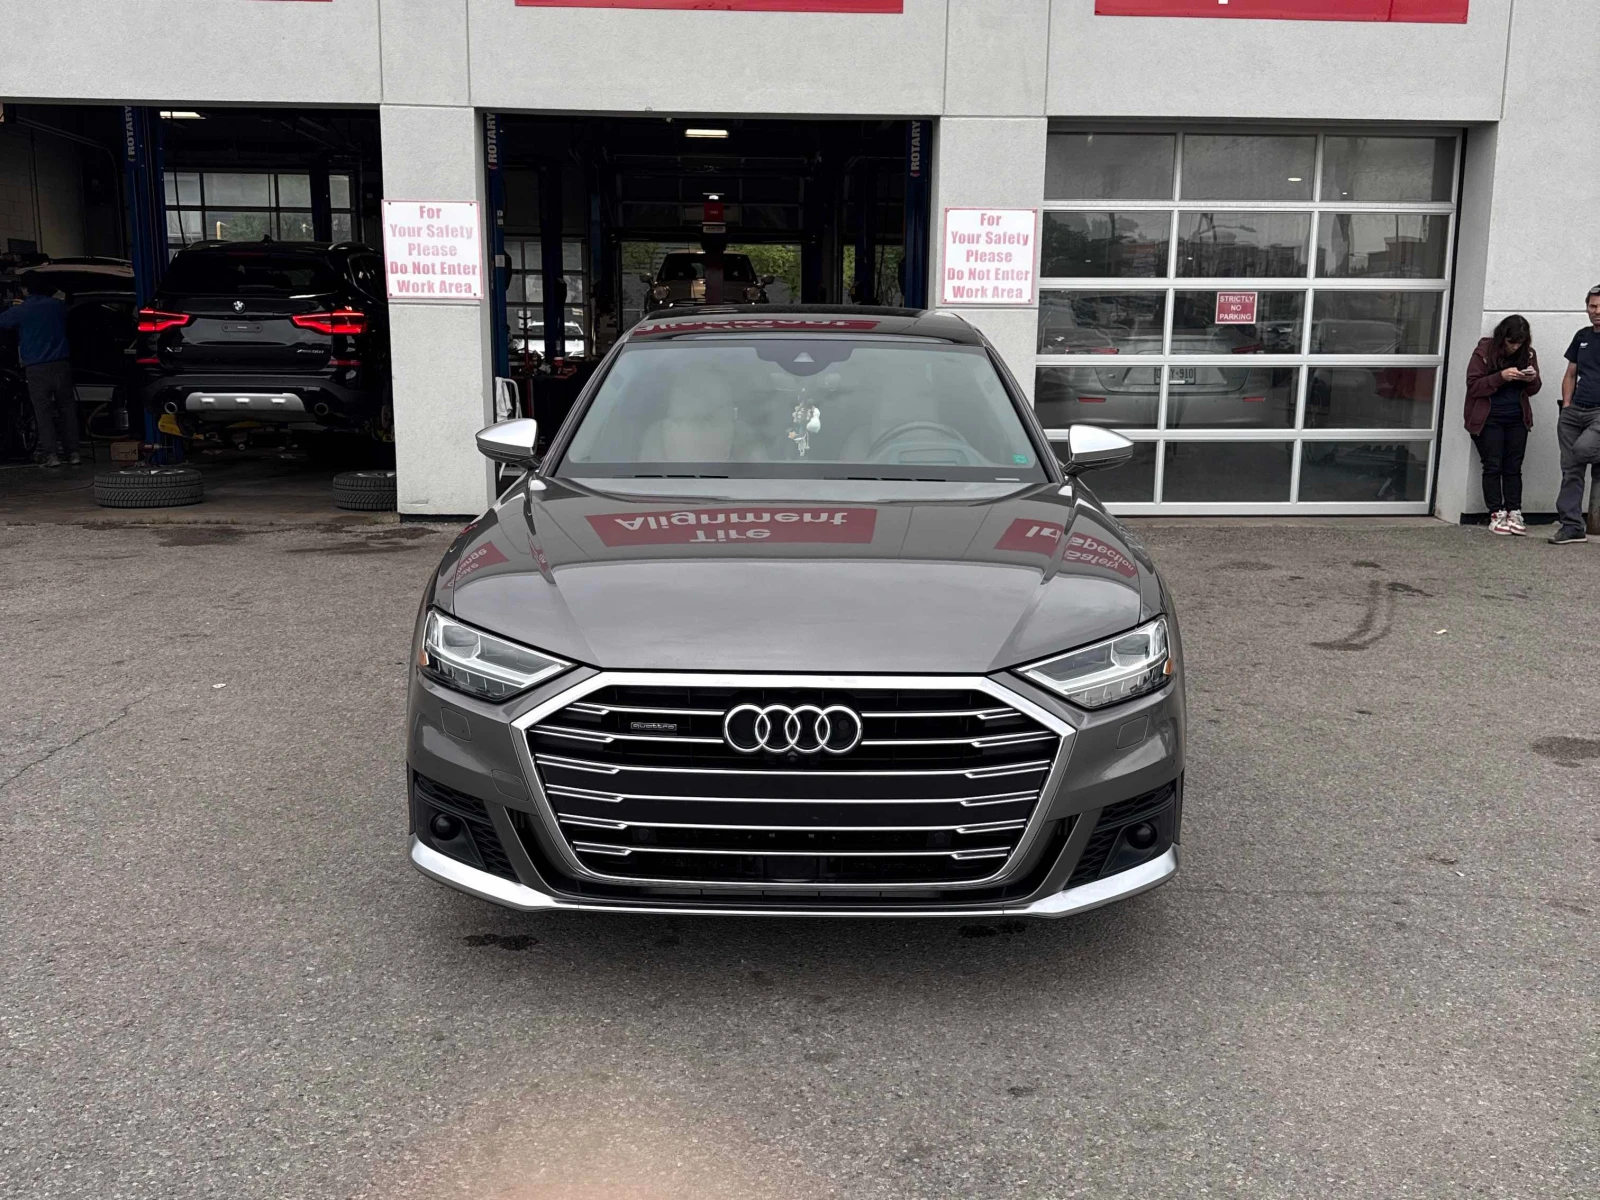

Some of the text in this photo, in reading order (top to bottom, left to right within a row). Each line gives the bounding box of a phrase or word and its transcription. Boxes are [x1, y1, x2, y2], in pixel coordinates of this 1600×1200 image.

[125, 105, 135, 155] ROTARY
[487, 113, 497, 163] ROTARY
[911, 121, 920, 170] ROTARY
[419, 206, 442, 219] For
[980, 213, 1002, 226] For
[389, 224, 473, 239] Your Safety
[951, 231, 1029, 246] Your Safety
[407, 243, 457, 256] Please
[966, 250, 1013, 262] Please
[389, 261, 477, 275] Do Not Enter
[947, 268, 1030, 281] Do Not Enter
[397, 280, 472, 293] Work Area
[952, 286, 1023, 298] Work Area
